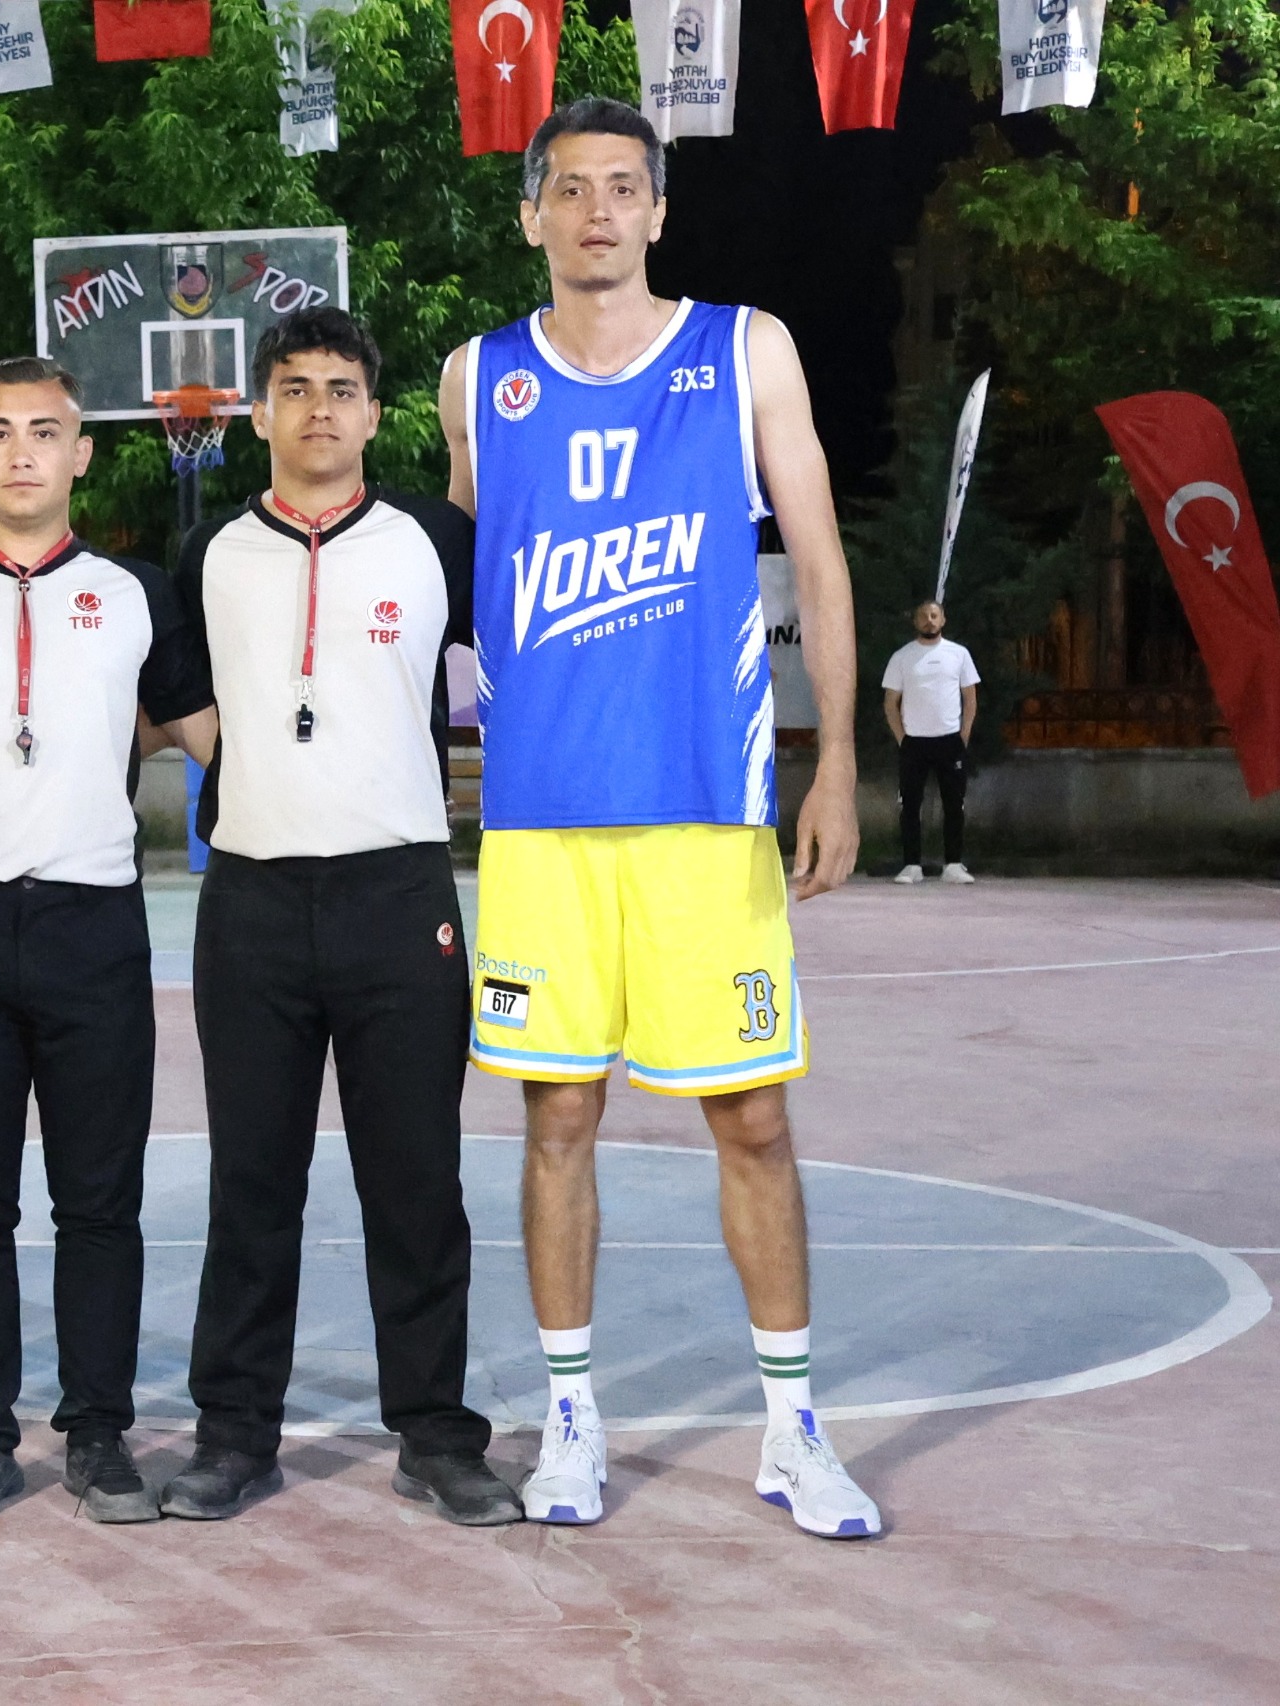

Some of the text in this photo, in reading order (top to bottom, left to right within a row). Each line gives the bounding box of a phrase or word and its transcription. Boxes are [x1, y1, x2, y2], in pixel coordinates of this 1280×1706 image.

[1029, 32, 1072, 50] HATAY
[53, 260, 144, 338] AYDIN
[503, 371, 530, 383] VOREN
[669, 365, 716, 393] 3X3
[524, 393, 538, 411] CLUB
[569, 426, 639, 502] 07
[512, 512, 706, 655] VOREN
[68, 616, 103, 630] TBF
[367, 629, 402, 644] TBF
[572, 598, 685, 647] SPORTS CLUB
[477, 951, 547, 983] Boston
[492, 991, 517, 1015] 617
[733, 968, 780, 1043] B
